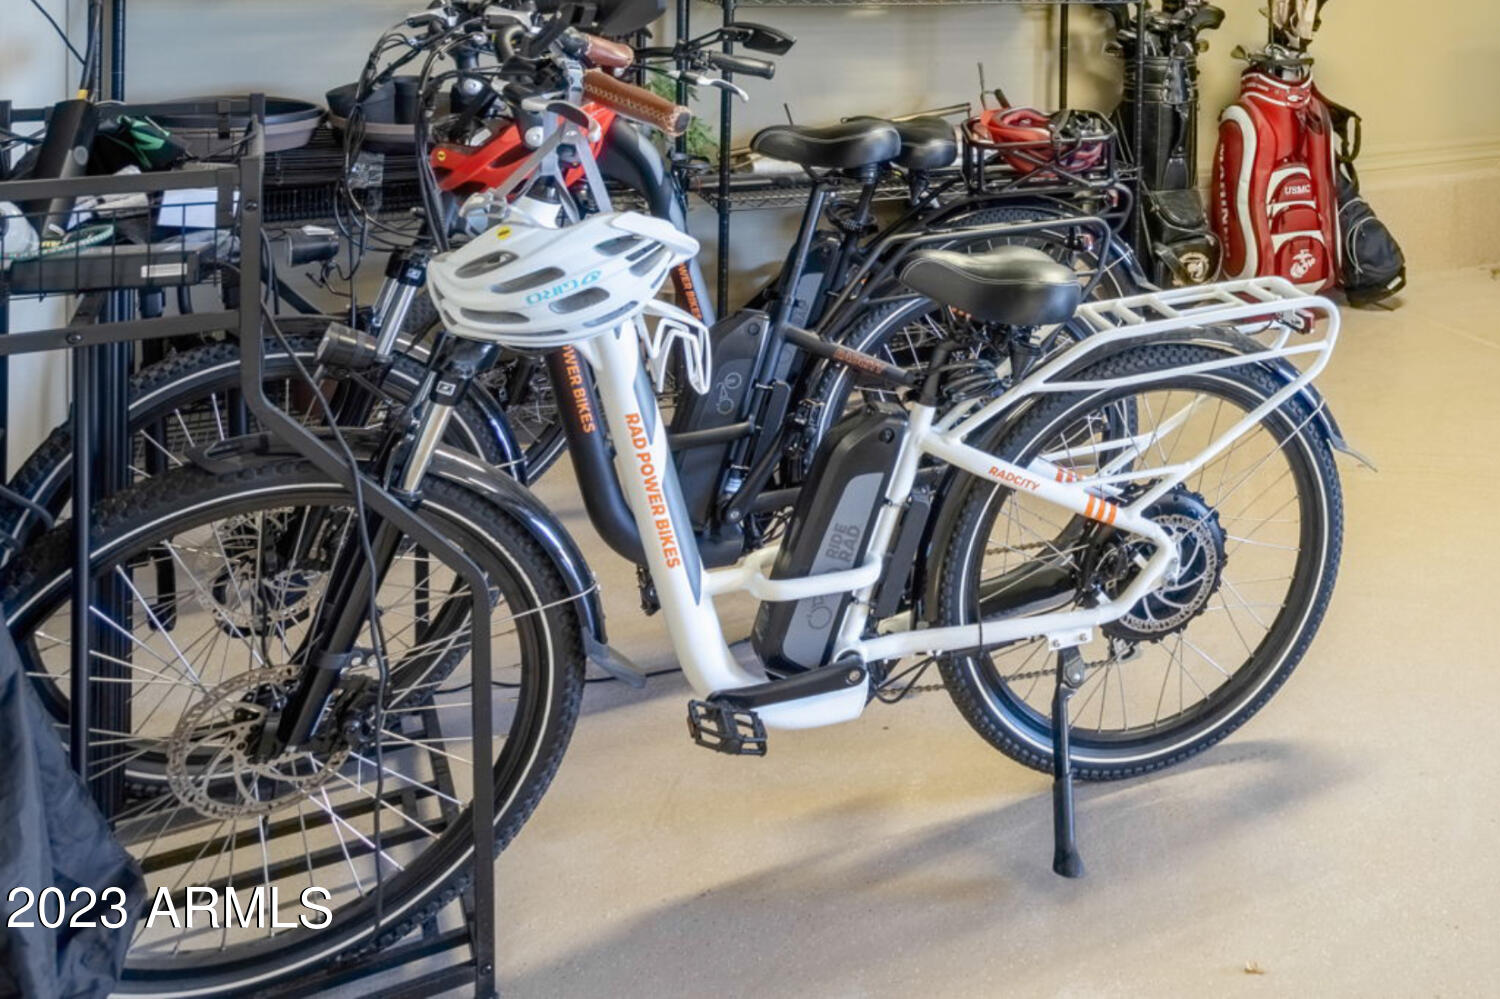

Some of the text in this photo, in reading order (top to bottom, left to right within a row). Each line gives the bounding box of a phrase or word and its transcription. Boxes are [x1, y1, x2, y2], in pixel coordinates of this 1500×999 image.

[1284, 183, 1311, 196] USMC
[526, 279, 580, 306] GIRO
[563, 344, 597, 434] WER BIKES
[624, 412, 681, 570] RAD POWER BIKES
[988, 465, 1041, 491] RADCITY
[825, 522, 848, 560] RIDE
[838, 524, 861, 562] RAD
